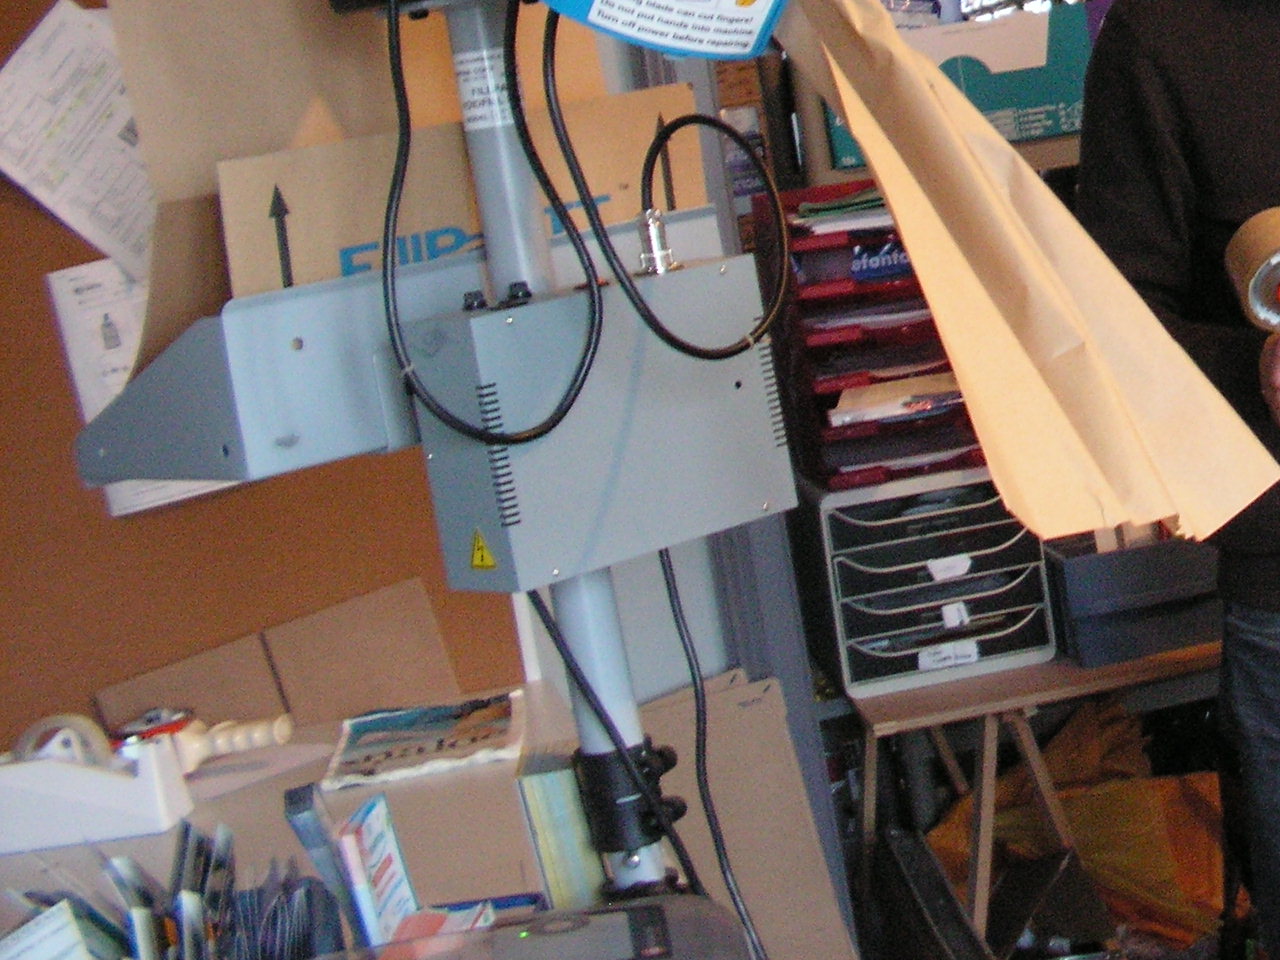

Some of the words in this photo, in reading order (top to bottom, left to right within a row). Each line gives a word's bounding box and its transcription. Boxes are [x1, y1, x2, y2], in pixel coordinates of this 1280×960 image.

[596, 9, 619, 24] Turn
[621, 18, 636, 29] off
[637, 24, 669, 39] power
[671, 32, 704, 45] before
[617, 3, 636, 15] not
[636, 9, 655, 22] put
[656, 15, 689, 30] hands
[691, 22, 711, 33] into
[677, 7, 695, 17] can
[698, 10, 714, 21] cut
